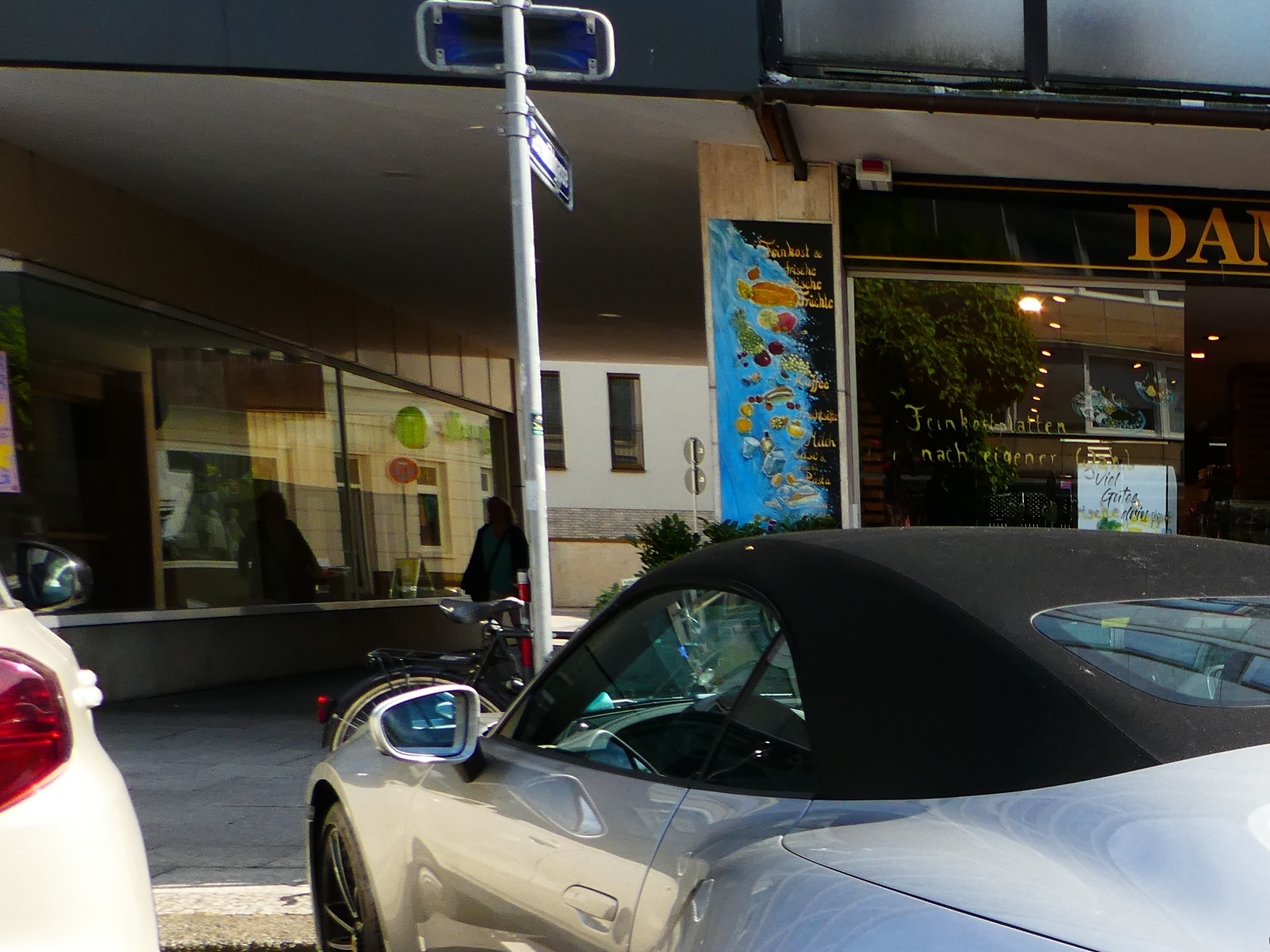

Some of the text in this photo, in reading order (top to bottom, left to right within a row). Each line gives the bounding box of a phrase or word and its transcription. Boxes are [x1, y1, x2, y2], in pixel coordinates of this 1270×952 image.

[759, 239, 823, 259] Feinkost &
[921, 442, 968, 463] nach
[984, 448, 1057, 466] eigener
[1089, 470, 1121, 486] Viel
[1101, 487, 1139, 507] Gutes
